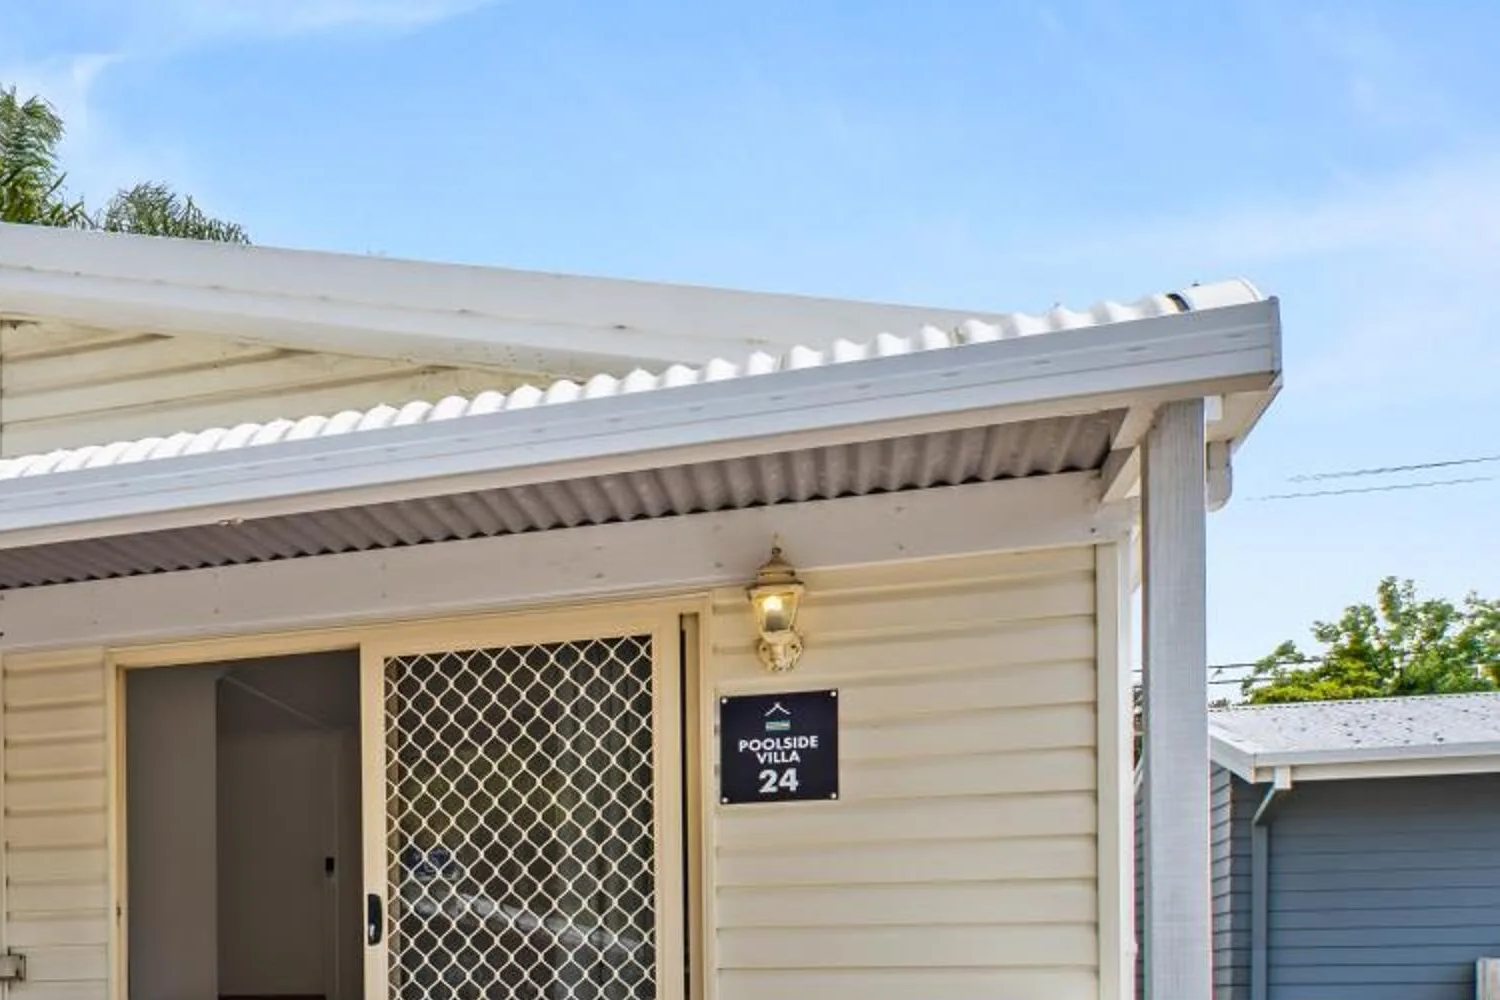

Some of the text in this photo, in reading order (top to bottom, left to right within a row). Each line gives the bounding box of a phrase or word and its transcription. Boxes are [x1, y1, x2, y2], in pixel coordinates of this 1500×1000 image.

[738, 735, 819, 753] POOLSIDE
[756, 751, 801, 764] VILLA
[758, 767, 799, 794] 24
